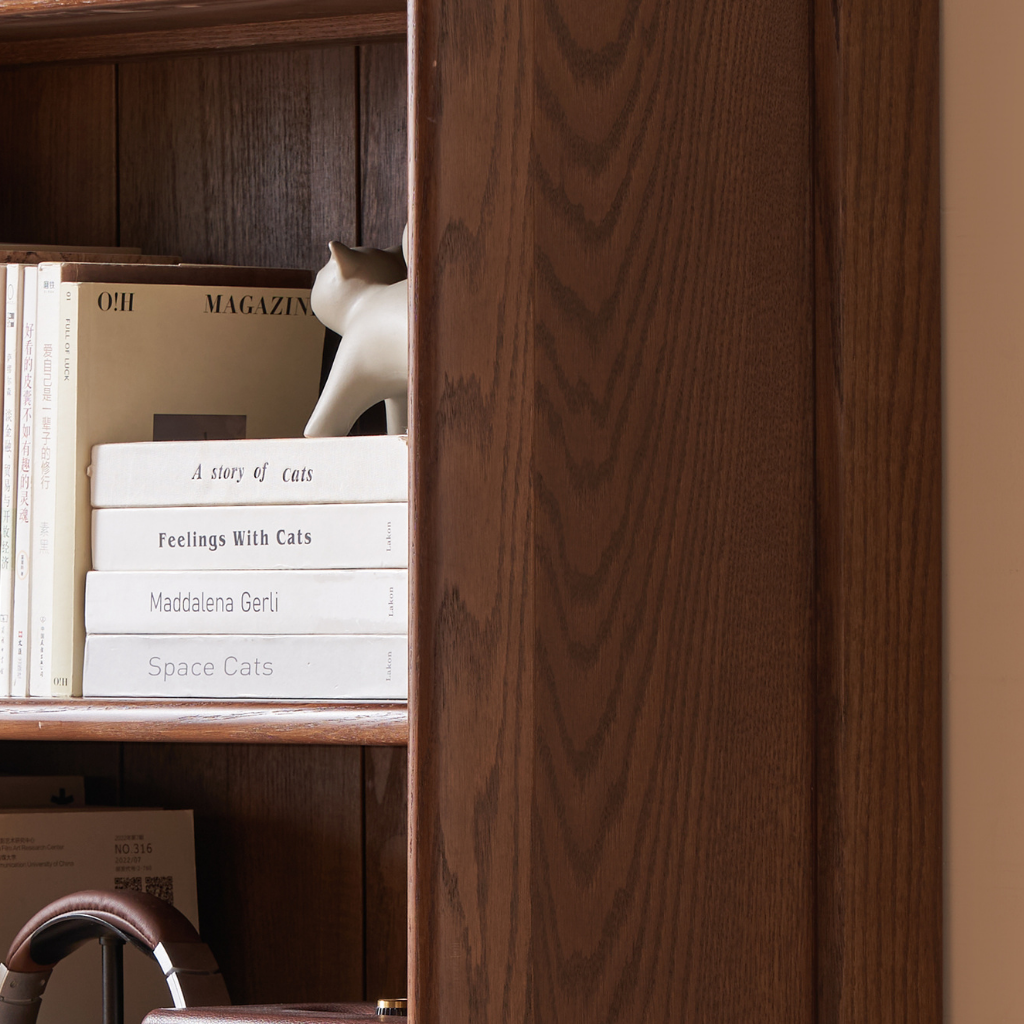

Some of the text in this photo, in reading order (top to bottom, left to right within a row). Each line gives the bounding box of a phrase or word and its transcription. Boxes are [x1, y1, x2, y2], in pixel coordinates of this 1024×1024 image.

[97, 291, 316, 316] O!H MAGAZIN
[64, 342, 71, 354] OF
[19, 323, 34, 523] 好看的皮囊不如有趣的灵魂
[40, 344, 53, 489] 爱自己是一辈子的修行
[192, 462, 314, 483] A story of Cats
[1, 409, 13, 571] 谈金融、贸易与开放经济
[39, 522, 49, 554] 素黑
[159, 529, 312, 551] Feelings With Cats
[150, 592, 279, 612] Maddalena Gerli
[148, 656, 274, 681] Space Cats
[54, 677, 68, 686] O!H
[115, 843, 153, 854] NO.316
